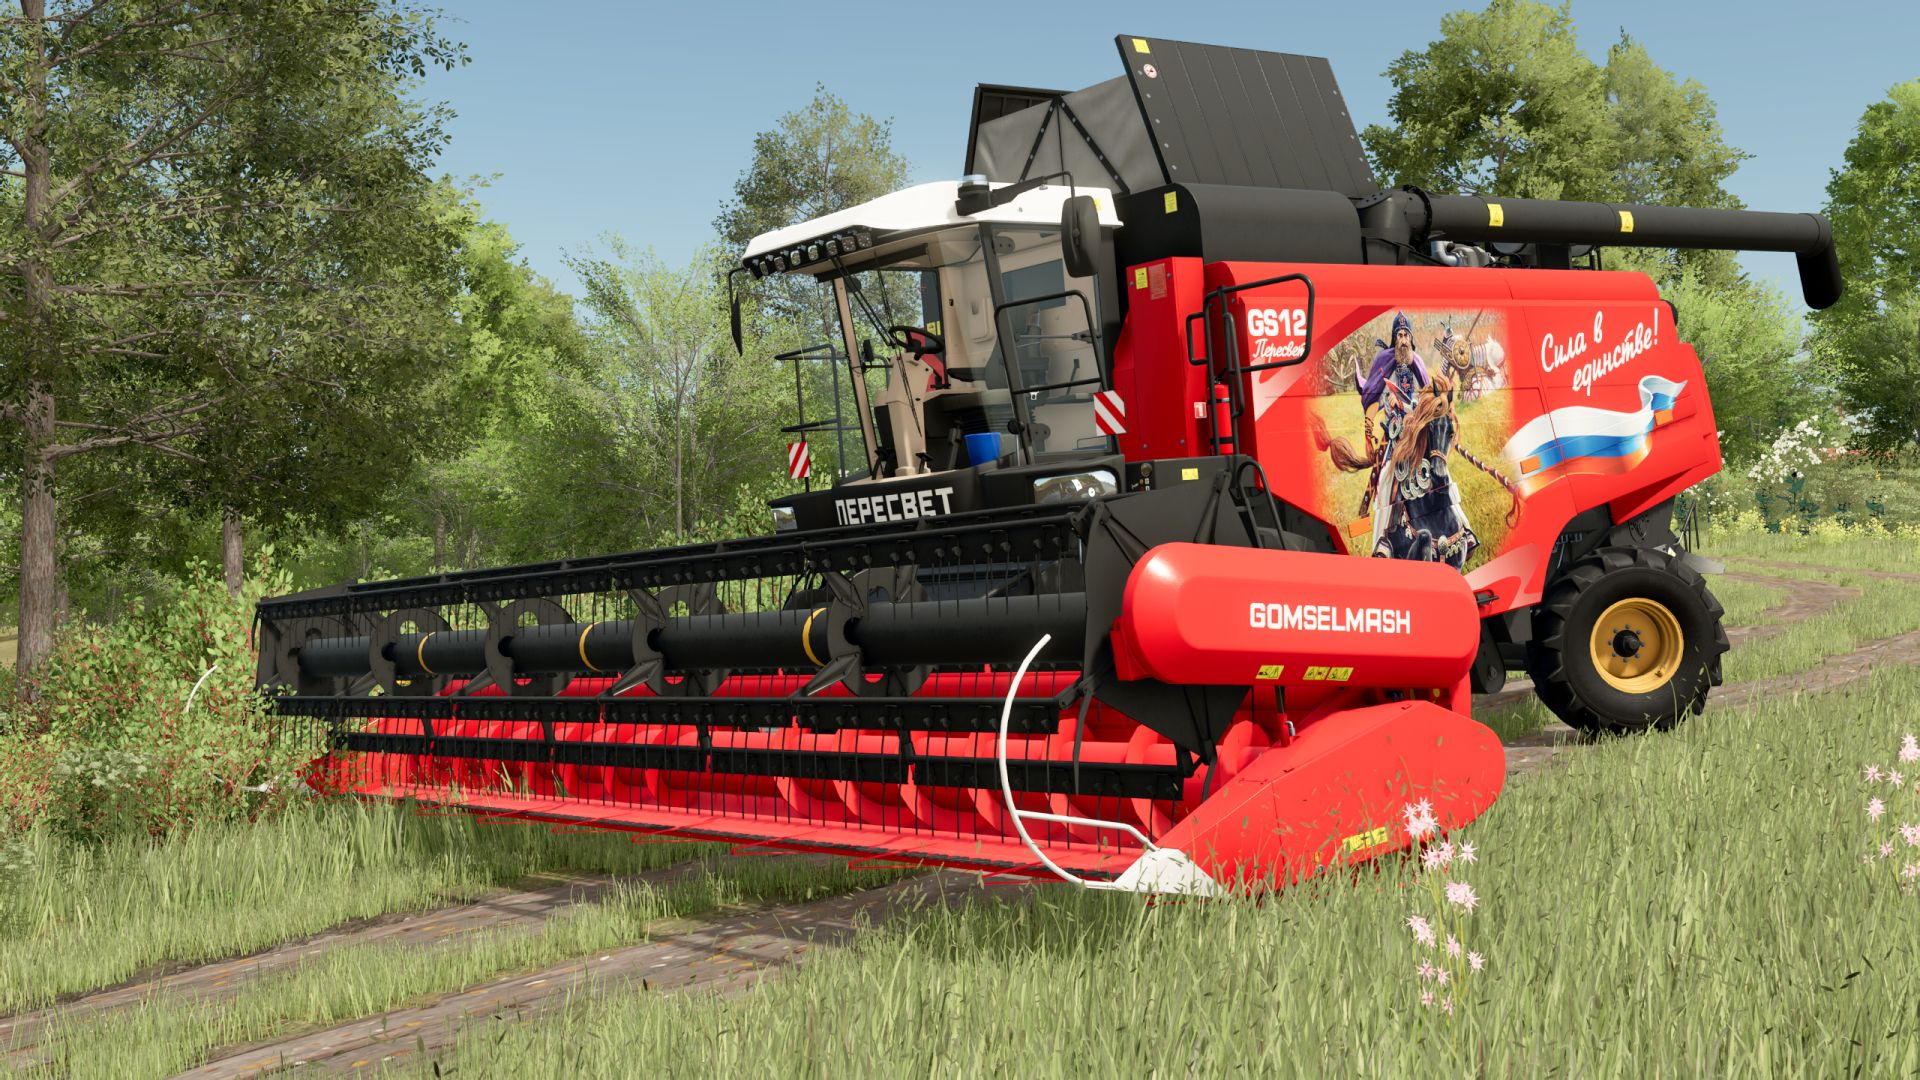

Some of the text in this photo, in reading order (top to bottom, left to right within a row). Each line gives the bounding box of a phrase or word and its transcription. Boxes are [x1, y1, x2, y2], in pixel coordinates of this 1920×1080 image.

[1247, 308, 1307, 337] GS12
[1541, 310, 1603, 373] Сила в
[1572, 307, 1659, 397] единстве!
[835, 487, 954, 526] ПЕРЕСВЕТ
[1250, 602, 1411, 635] GOMSELMASH
